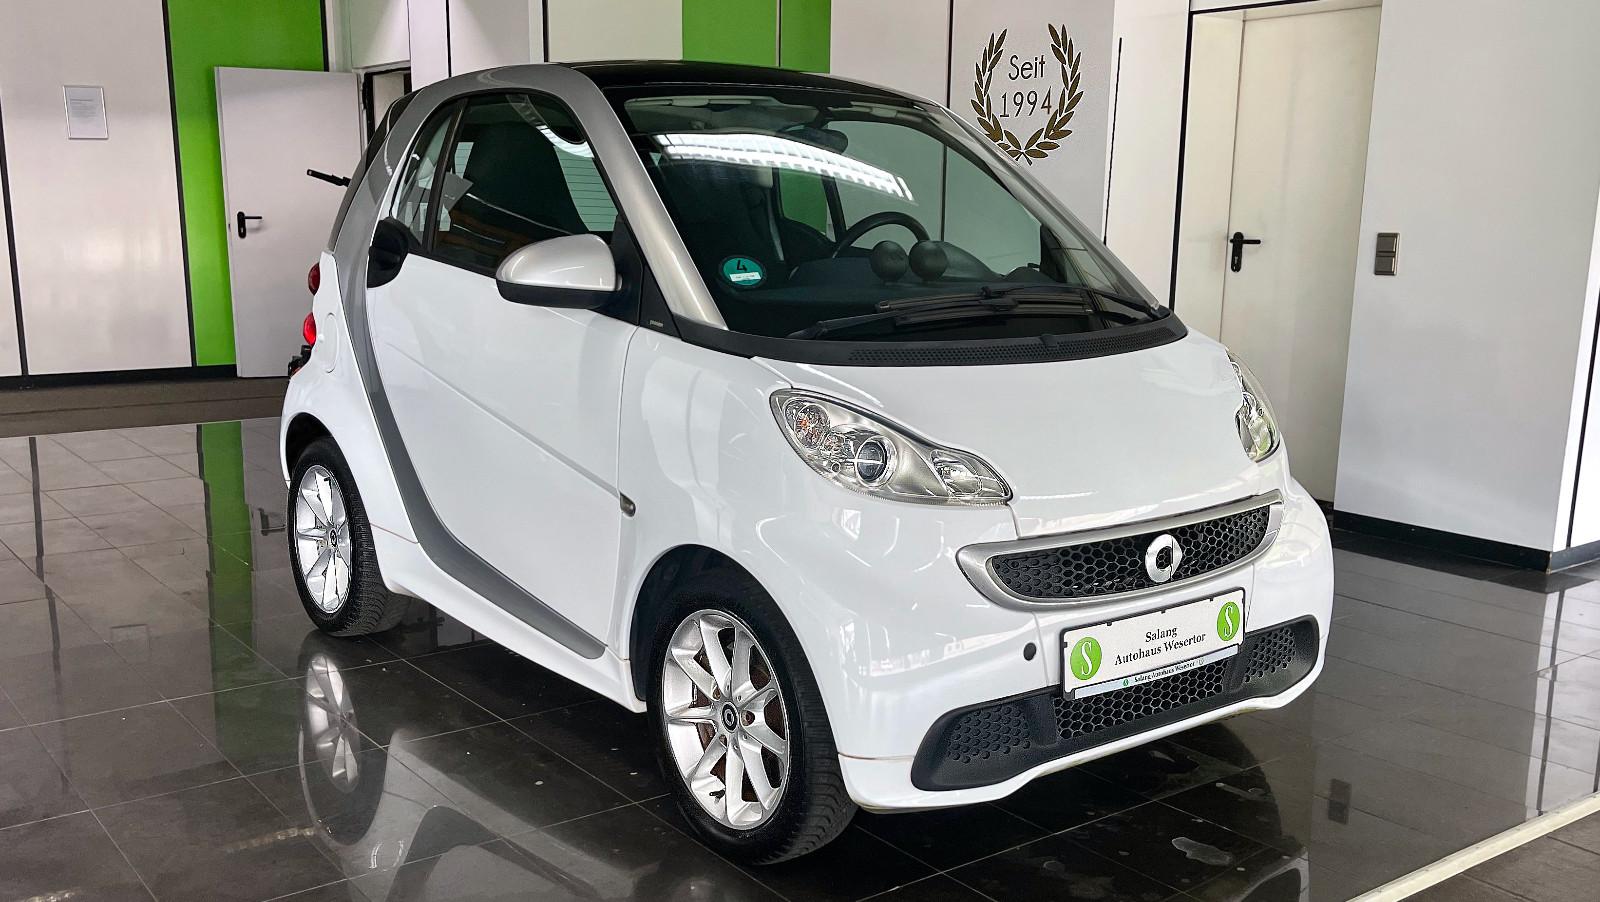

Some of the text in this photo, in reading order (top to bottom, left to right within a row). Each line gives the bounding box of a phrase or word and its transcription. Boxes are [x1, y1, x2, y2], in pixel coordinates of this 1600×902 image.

[1008, 54, 1046, 80] Seit
[1000, 86, 1053, 118] 1994
[736, 259, 748, 271] 4
[1114, 632, 1206, 666] Autohaus Wesertor
[1145, 626, 1178, 643] Salang
[1081, 641, 1092, 676] S
